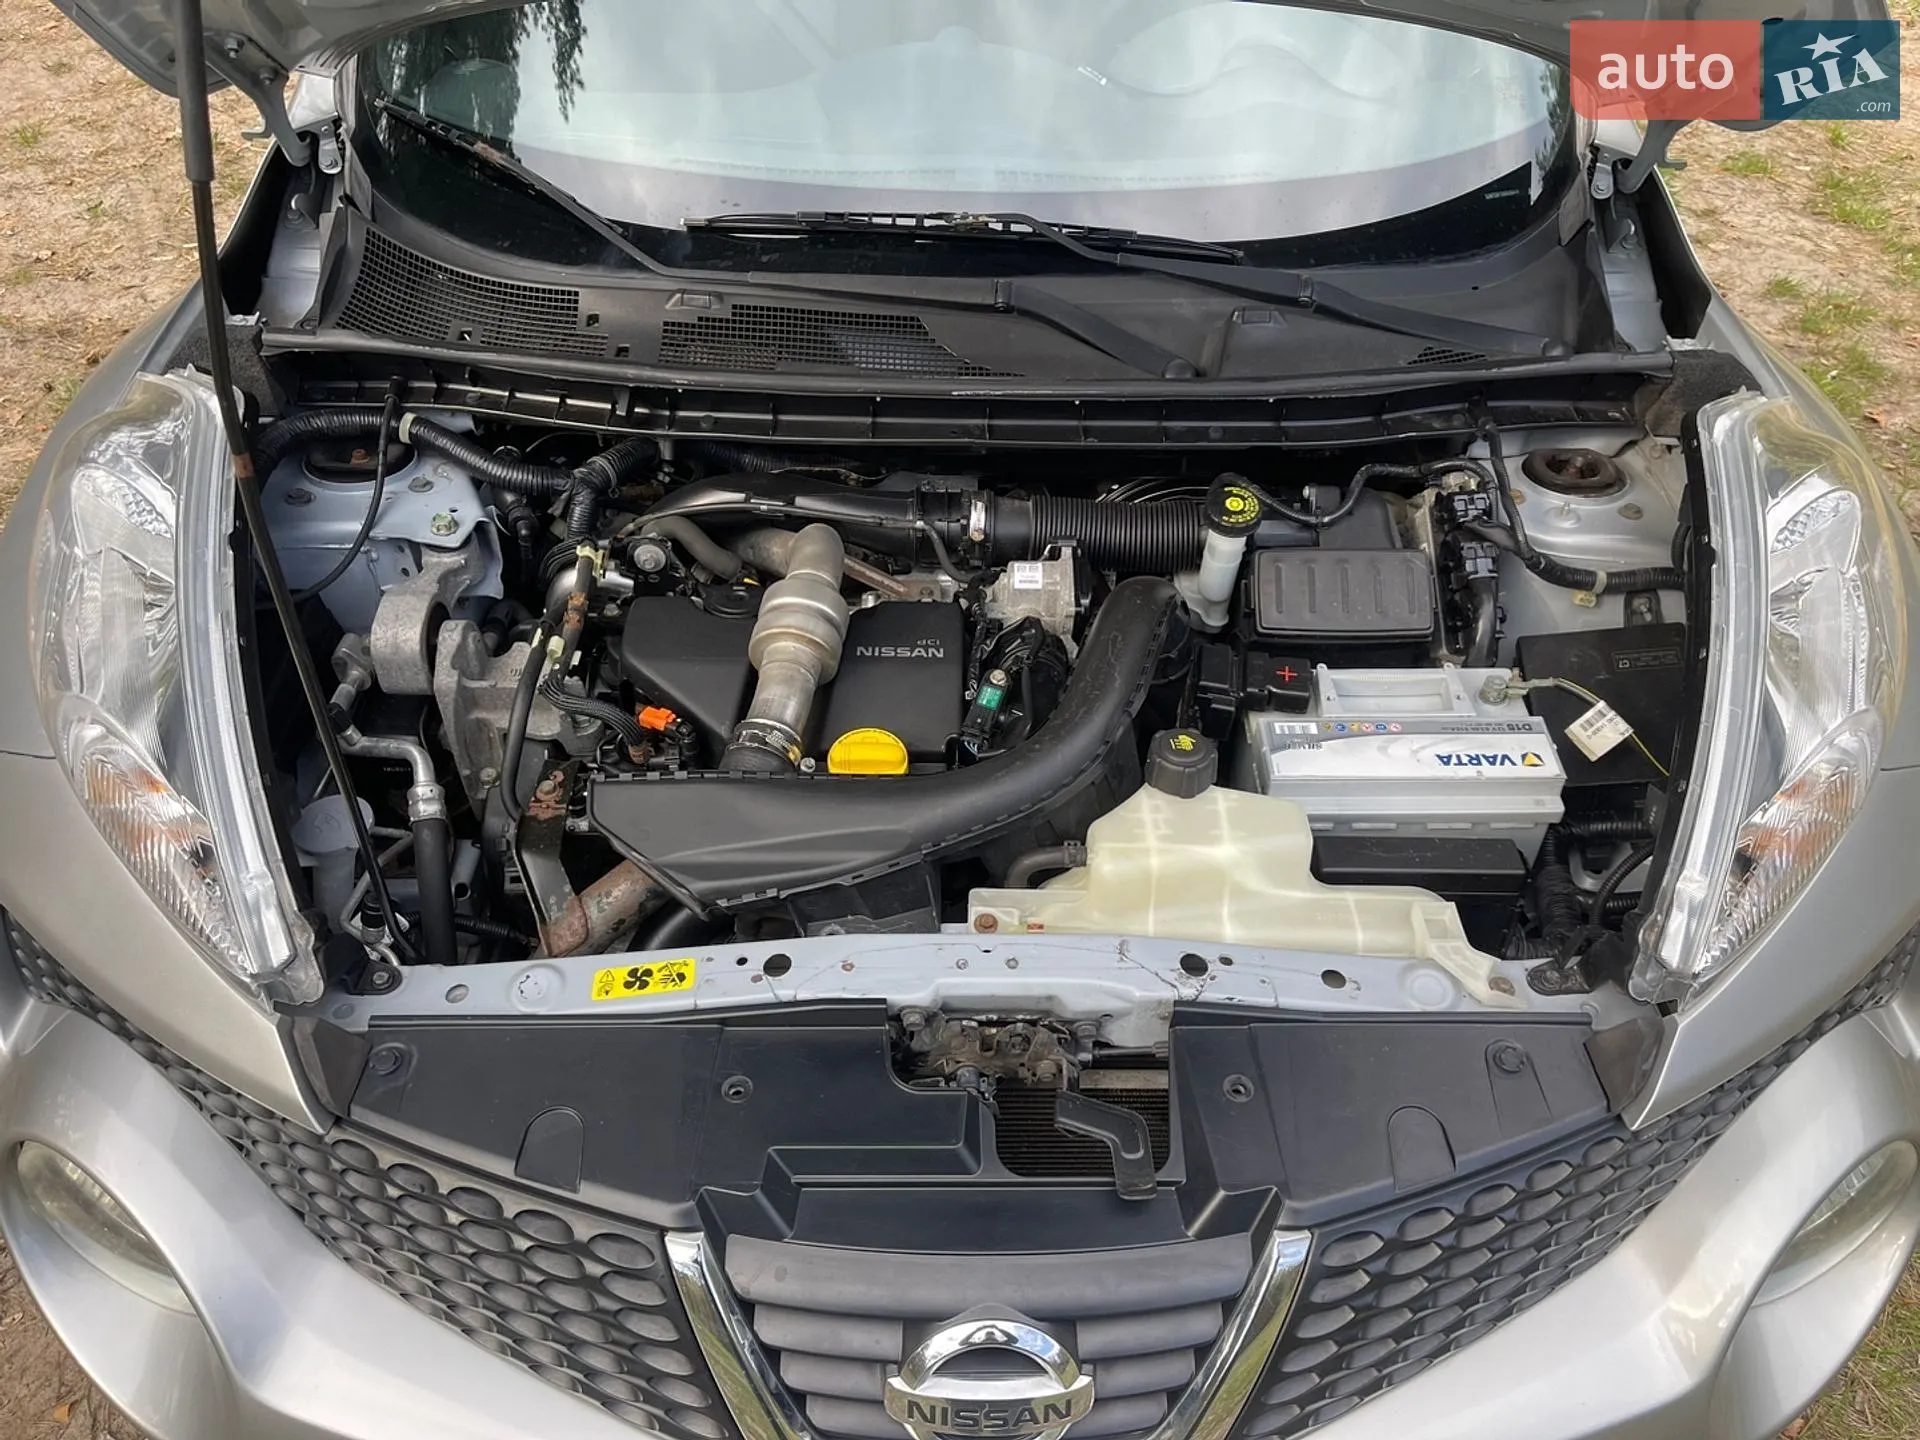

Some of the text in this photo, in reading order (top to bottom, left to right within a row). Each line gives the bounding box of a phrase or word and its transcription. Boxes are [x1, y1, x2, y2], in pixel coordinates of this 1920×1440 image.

[856, 646, 944, 658] NISSAN
[1435, 753, 1518, 767] VARTA
[906, 1399, 1073, 1430] NISSAN
